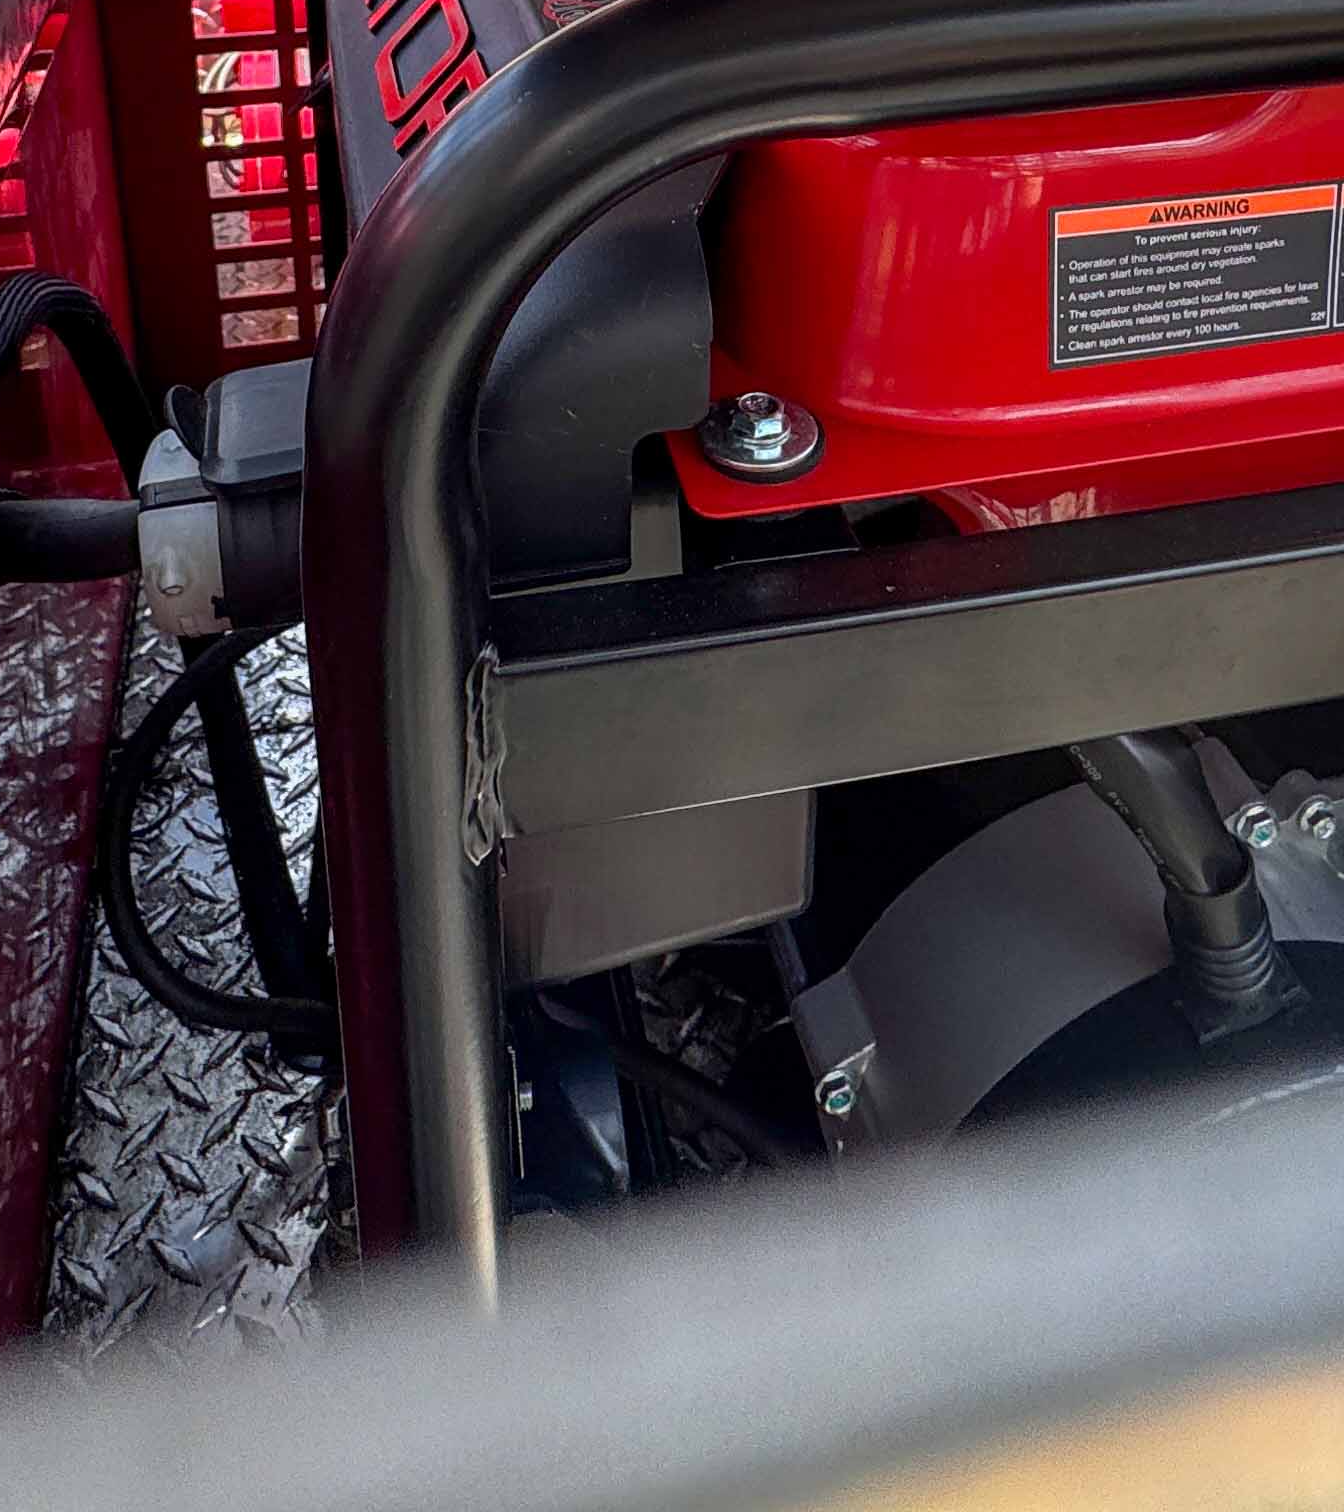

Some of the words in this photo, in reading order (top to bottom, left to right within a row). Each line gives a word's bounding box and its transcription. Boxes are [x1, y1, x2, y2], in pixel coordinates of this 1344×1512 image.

[1163, 199, 1249, 221] WARNING
[1134, 235, 1147, 245] To
[1149, 230, 1188, 246] prevent
[1190, 228, 1227, 239] serious
[1068, 258, 1116, 272] Operation
[1119, 255, 1128, 265] of
[1130, 254, 1148, 263] this
[1149, 248, 1199, 263] equipment
[1201, 247, 1221, 257] may
[1223, 242, 1252, 253] create
[1254, 239, 1284, 252] sparks
[1068, 273, 1087, 283] that
[1089, 272, 1107, 281] can
[1110, 268, 1131, 279] start
[1133, 267, 1153, 276] fires
[1156, 262, 1189, 274] around
[1190, 261, 1206, 271] dry
[1068, 292, 1076, 301] A
[1078, 289, 1104, 302] spark
[1107, 285, 1144, 296] arrestor
[1146, 283, 1166, 293] may
[1168, 281, 1181, 289] be
[1069, 309, 1087, 319] The
[1089, 305, 1129, 319] operator
[1132, 300, 1163, 311] should
[1165, 295, 1199, 307] contact
[1200, 292, 1223, 303] local
[1224, 291, 1239, 300] fire
[1241, 287, 1282, 300] agencies
[1283, 285, 1296, 293] for
[1297, 282, 1318, 291] laws
[1068, 325, 1078, 333] or
[1080, 318, 1133, 333] regulations
[1135, 313, 1170, 324] relating
[1171, 311, 1181, 320] to
[1183, 309, 1198, 318] fire
[1200, 303, 1248, 319] prevention
[1068, 341, 1096, 351] Clean
[1099, 336, 1125, 349] spark
[1127, 332, 1163, 343] arrestor
[1165, 328, 1191, 338] every
[1194, 324, 1211, 334] 100
